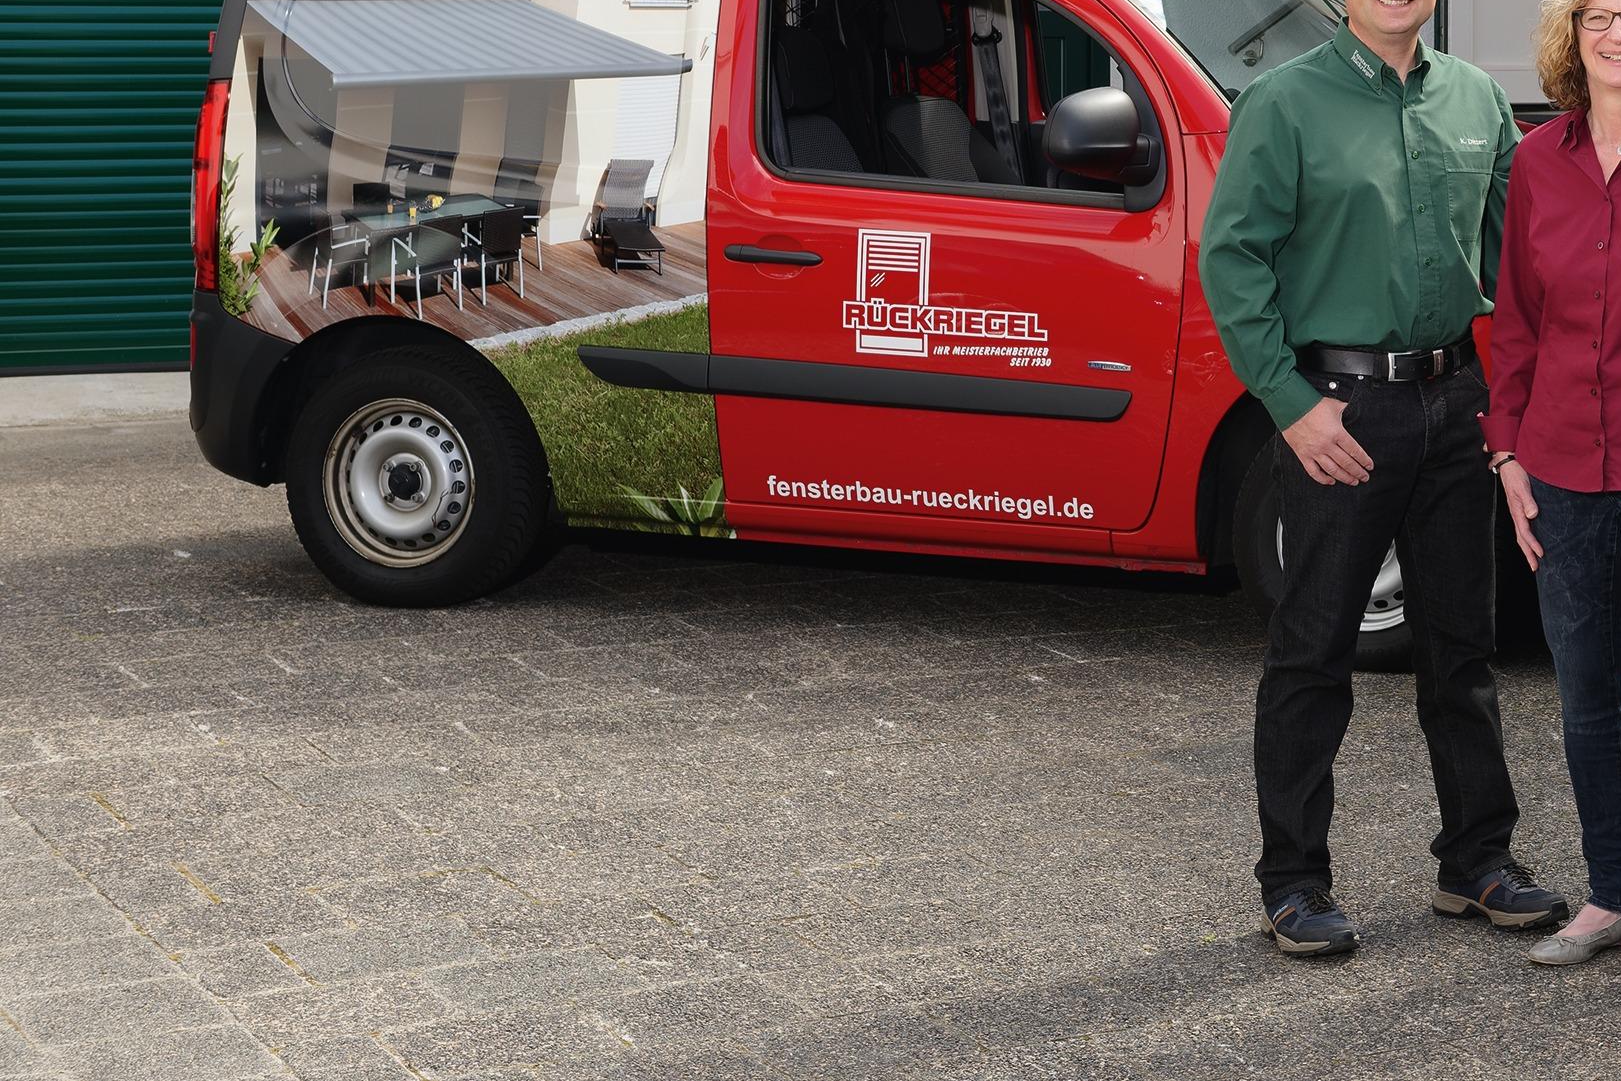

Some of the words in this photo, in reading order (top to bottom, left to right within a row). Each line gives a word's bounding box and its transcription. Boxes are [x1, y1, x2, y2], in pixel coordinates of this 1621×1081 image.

[842, 297, 1049, 342] RÜCKRIEGEL
[933, 345, 950, 356] IHR
[952, 345, 1049, 357] MEISTERFACHBETRIEB
[1009, 357, 1029, 367] SEIT
[1030, 357, 1052, 367] 1930
[767, 475, 1095, 520] fensterbau-rueckriegel.de
